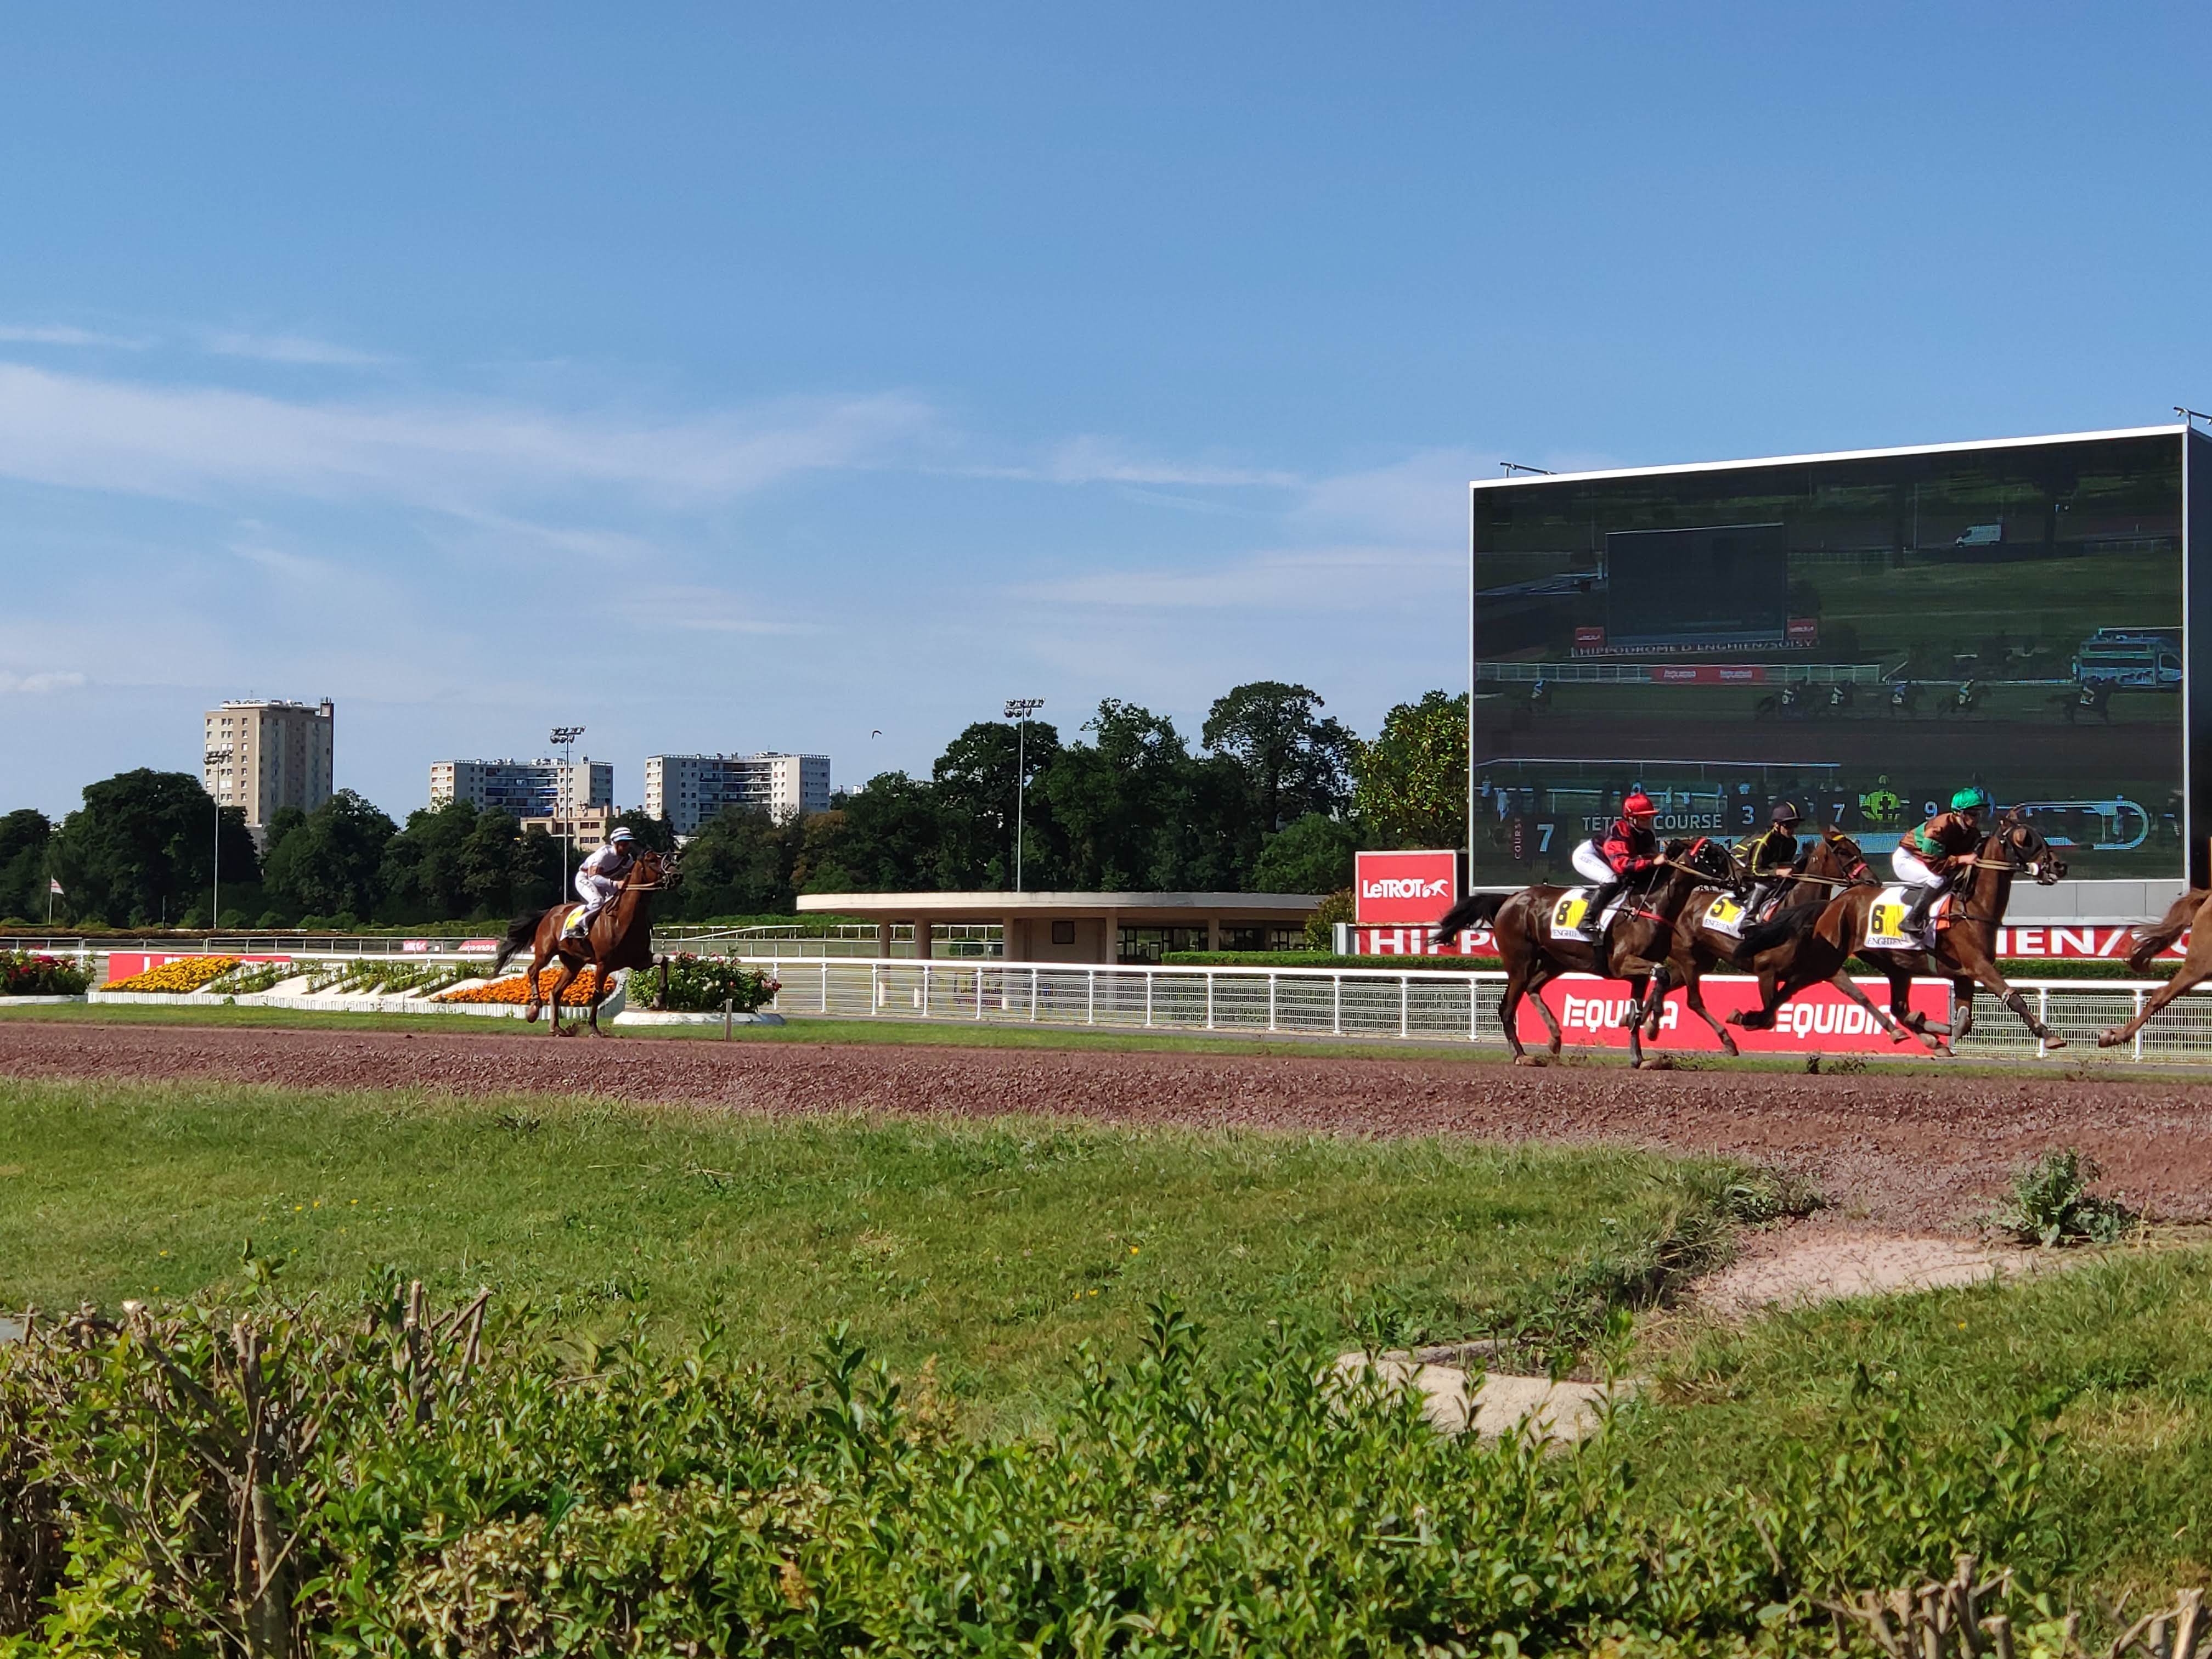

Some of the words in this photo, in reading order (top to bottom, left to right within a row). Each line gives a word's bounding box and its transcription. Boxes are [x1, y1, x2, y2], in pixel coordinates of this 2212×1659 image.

[1742, 804, 1754, 825] 3
[1832, 803, 1845, 823] 7
[1923, 800, 1938, 820] 9
[1653, 814, 1723, 830] COURSE
[1537, 824, 1554, 852] 7
[1555, 900, 1572, 926] 8
[1709, 896, 1731, 918] 5
[1871, 904, 1886, 934] 6
